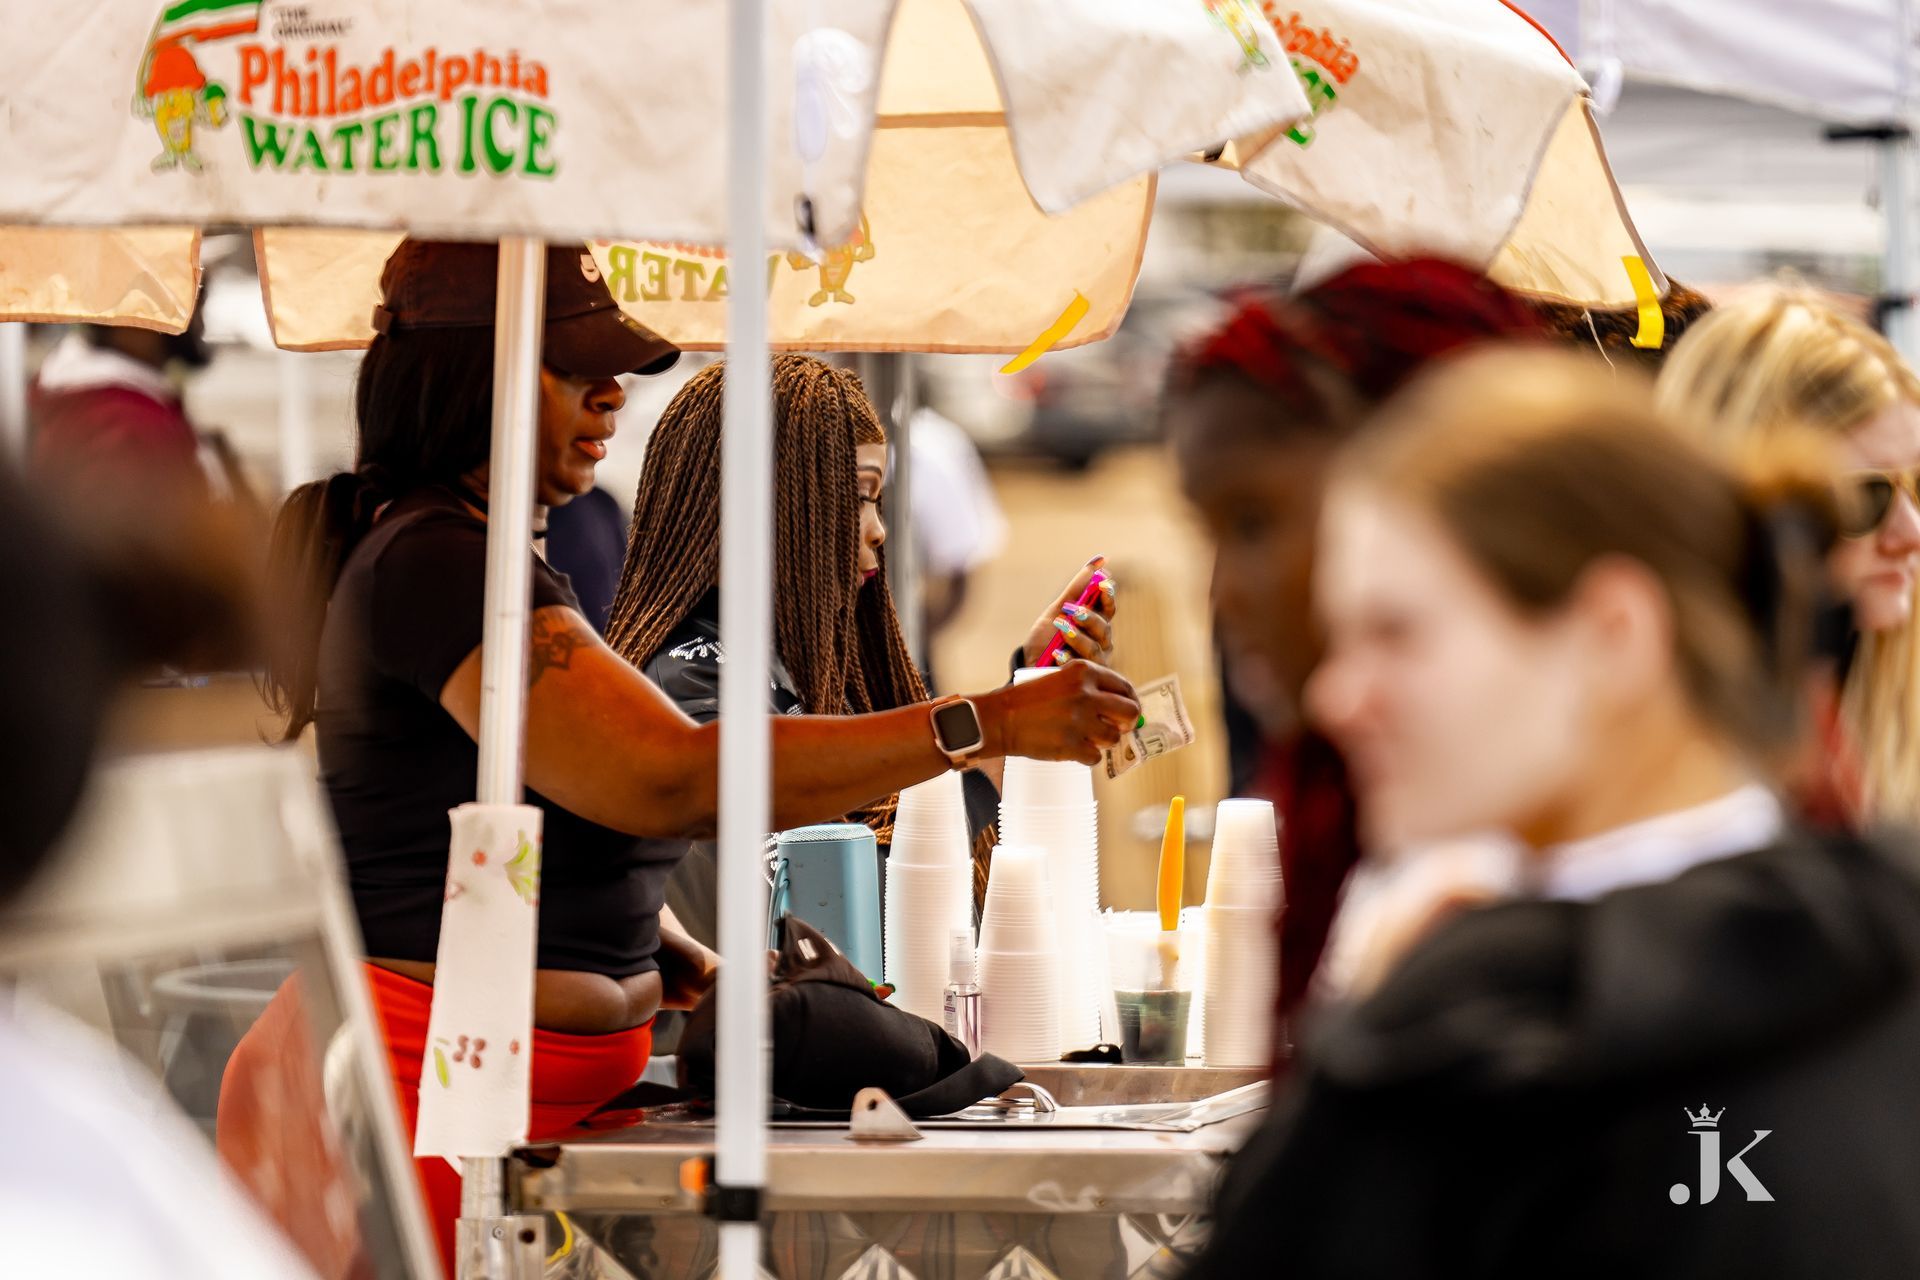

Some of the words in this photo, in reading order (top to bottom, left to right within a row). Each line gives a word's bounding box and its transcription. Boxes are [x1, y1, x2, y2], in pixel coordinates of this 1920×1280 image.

[237, 45, 548, 118] Philadelphia
[241, 103, 441, 172] WATER
[459, 96, 557, 176] ICE
